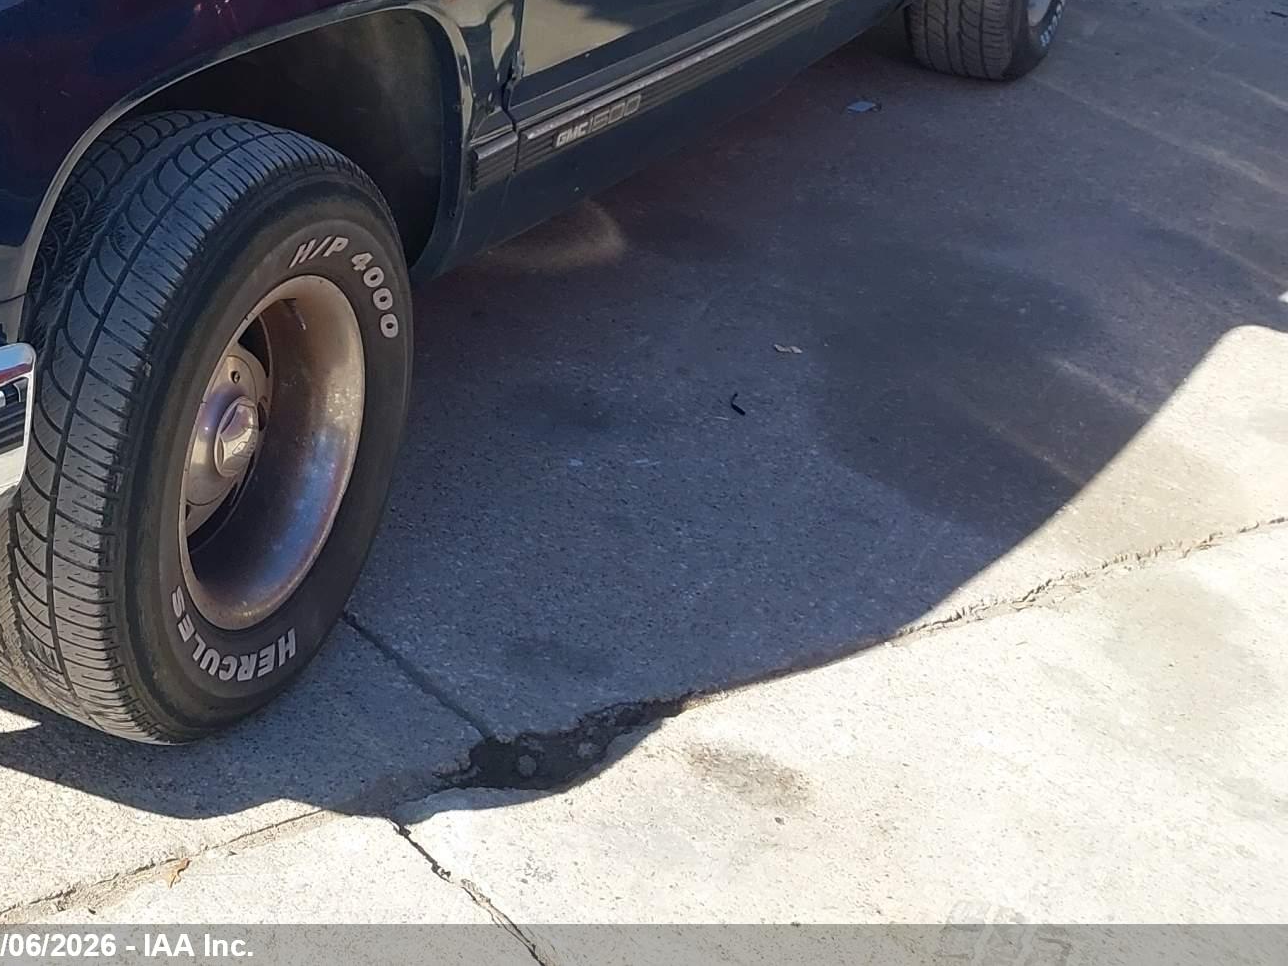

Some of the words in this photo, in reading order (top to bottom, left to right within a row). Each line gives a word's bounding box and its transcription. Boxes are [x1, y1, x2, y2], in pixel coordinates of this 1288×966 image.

[555, 121, 589, 147] GMC
[351, 252, 399, 338] 4000
[172, 585, 296, 682] HERCULES
